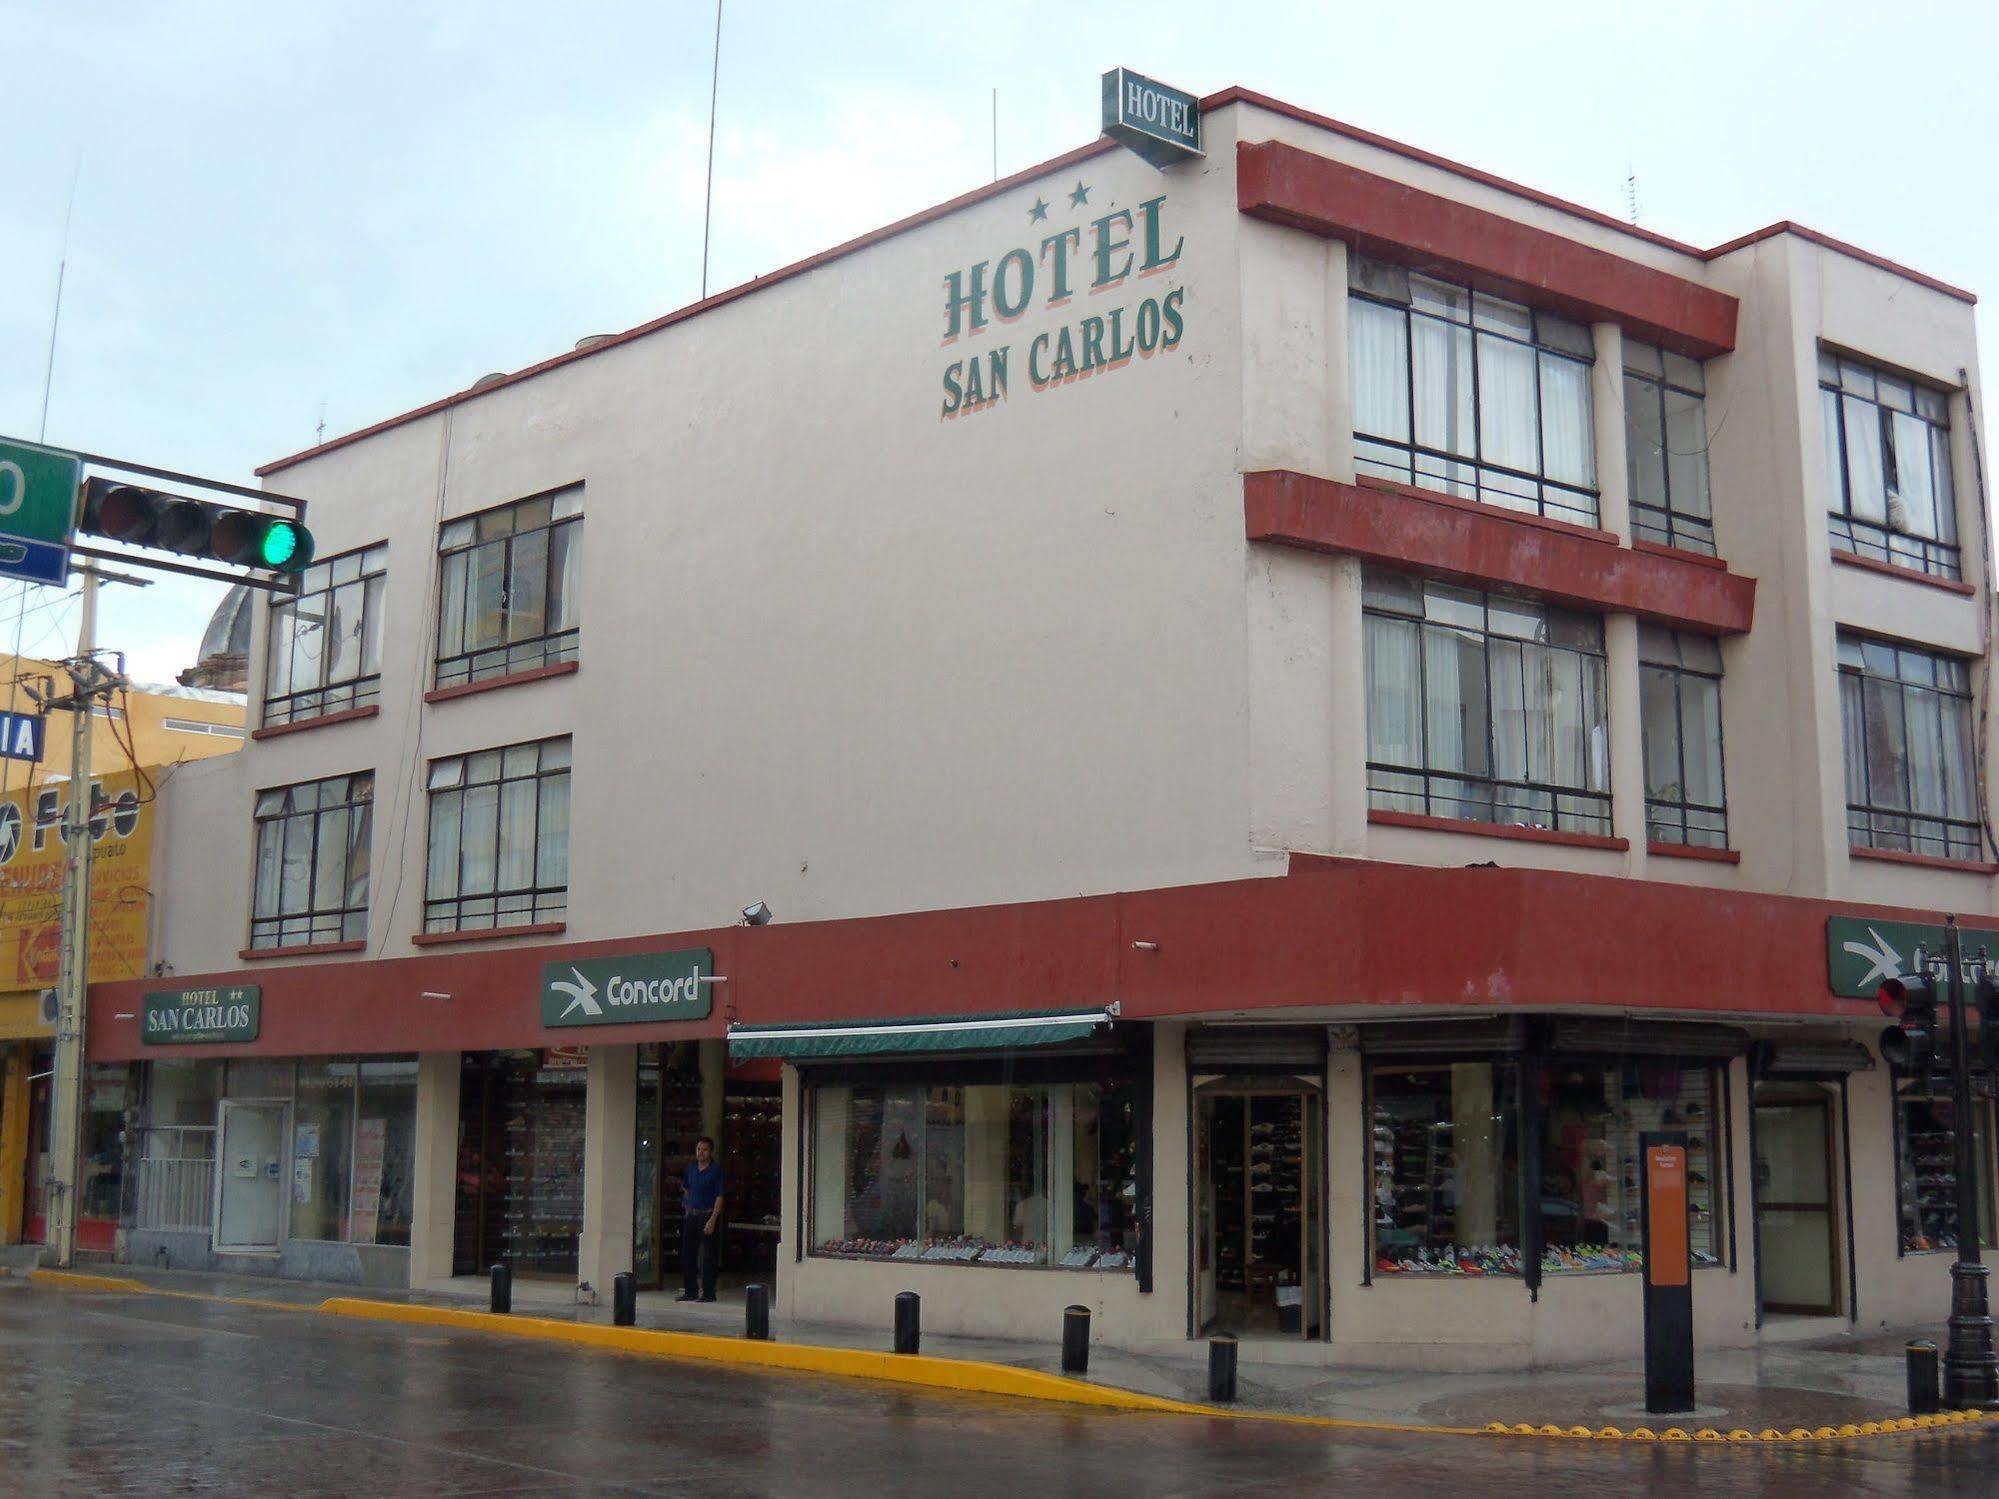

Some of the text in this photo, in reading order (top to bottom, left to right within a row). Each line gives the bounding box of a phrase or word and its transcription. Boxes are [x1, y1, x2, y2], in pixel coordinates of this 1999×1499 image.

[1127, 81, 1194, 137] HOTEL
[941, 195, 1184, 346] HOTEL
[941, 286, 1184, 421] SAN CARLOS
[182, 990, 219, 1006] HOTEL
[607, 965, 699, 1006] Concord
[148, 1005, 249, 1032] SAN CARLOS
